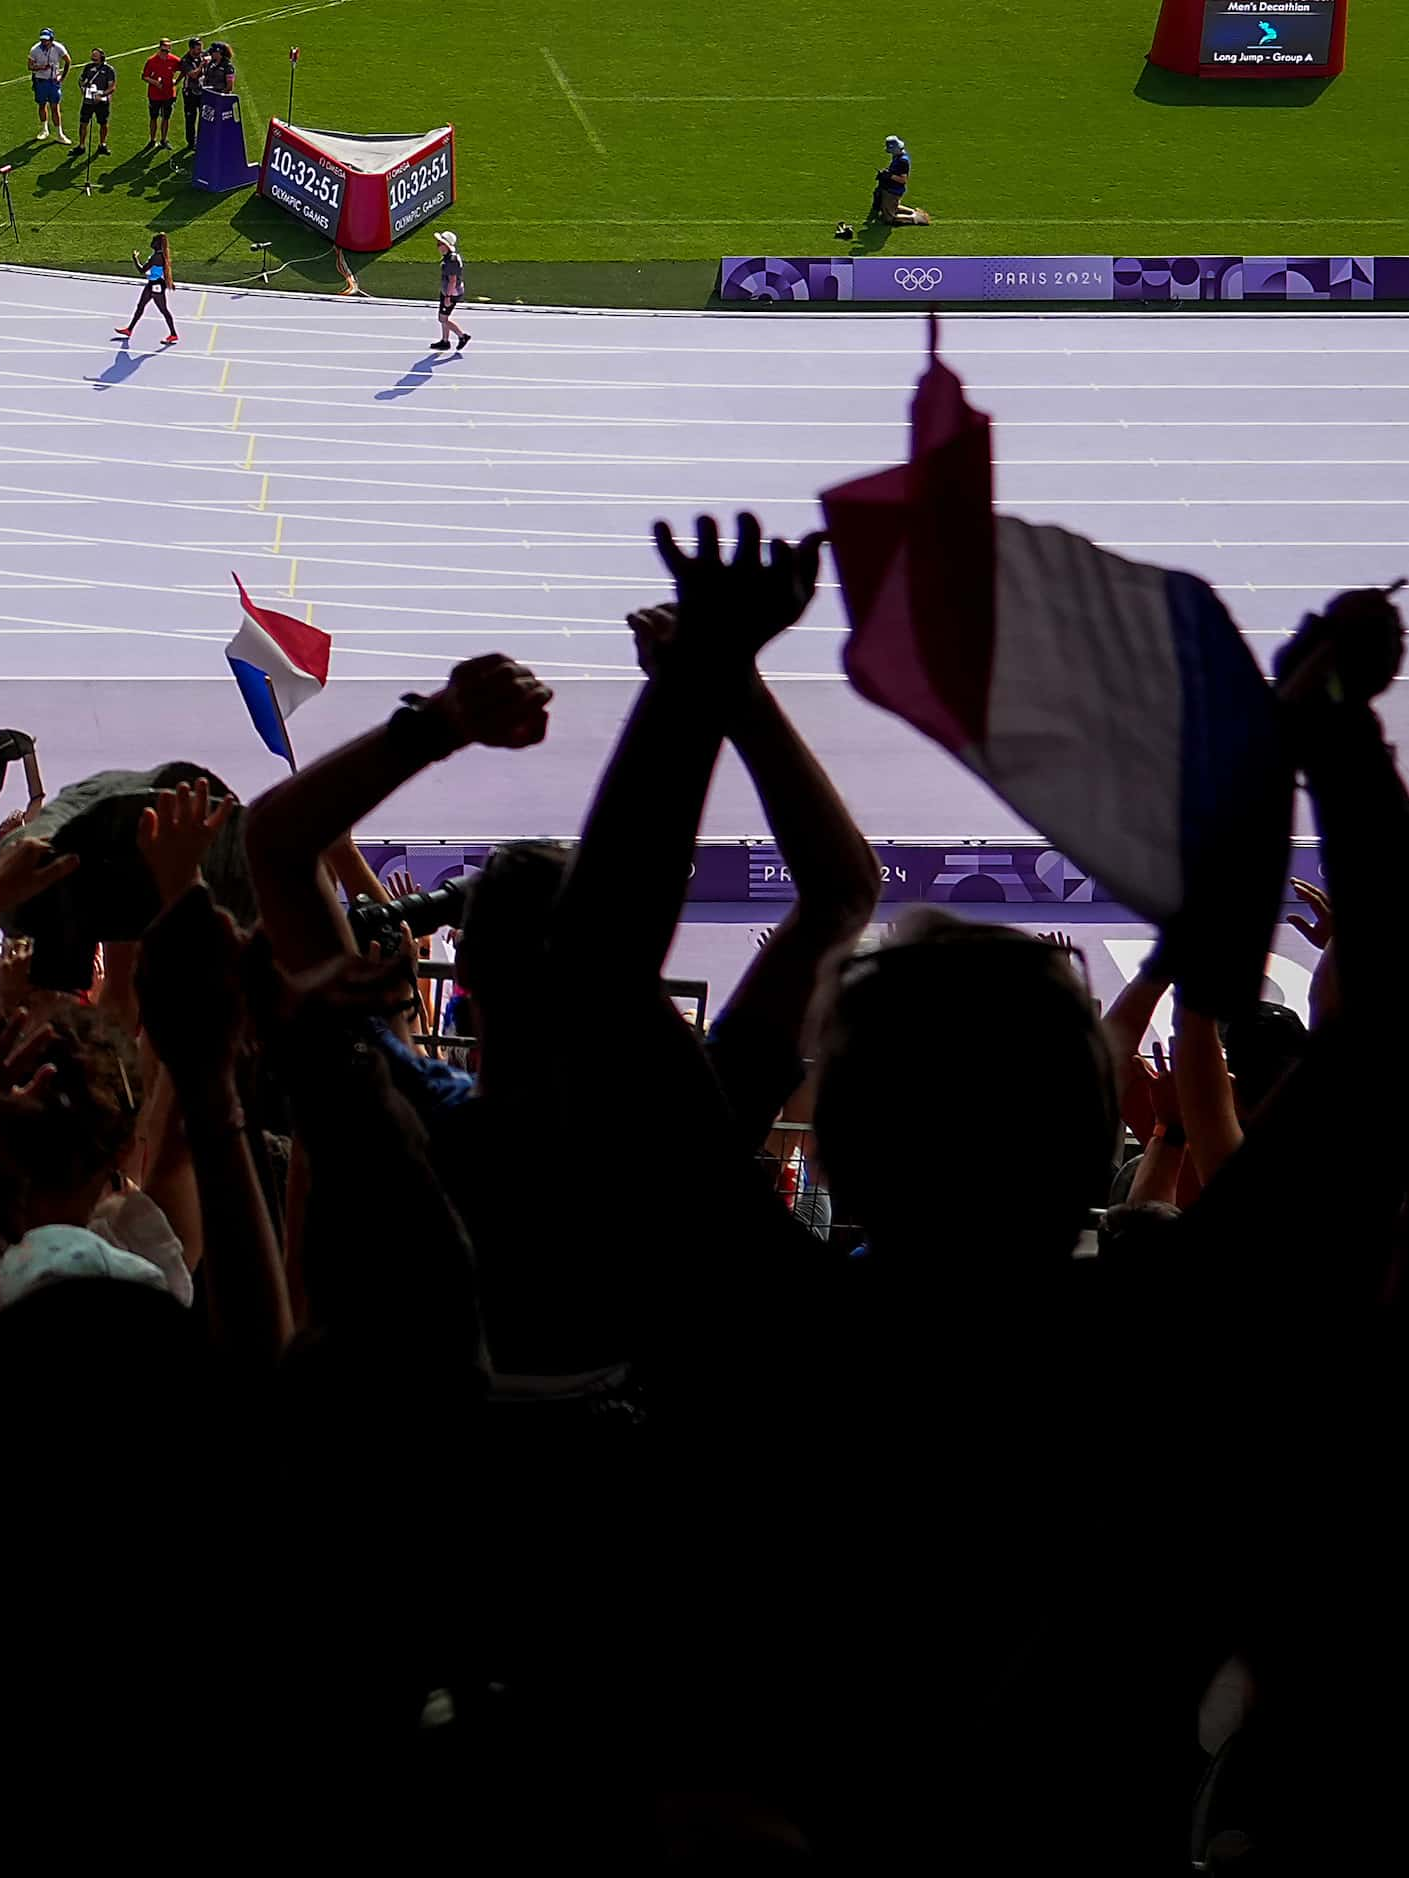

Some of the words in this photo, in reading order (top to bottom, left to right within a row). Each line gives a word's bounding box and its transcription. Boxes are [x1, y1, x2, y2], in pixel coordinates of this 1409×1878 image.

[1227, 2, 1257, 11] Men's
[1259, 2, 1310, 12] Decathlon
[1213, 52, 1237, 63] Long
[1238, 52, 1263, 63] Jump
[1272, 52, 1303, 63] Group
[1305, 53, 1313, 62] A
[270, 147, 340, 209] 10:32:51
[390, 153, 448, 210] 10:32:51
[271, 185, 302, 211] OLYMPIC
[303, 205, 329, 229] GAMES
[395, 207, 421, 231] OLYMPIC
[422, 191, 445, 213] GAMES
[994, 272, 1047, 285] PARIS
[1054, 272, 1102, 285] 2024
[879, 865, 907, 882] 24
